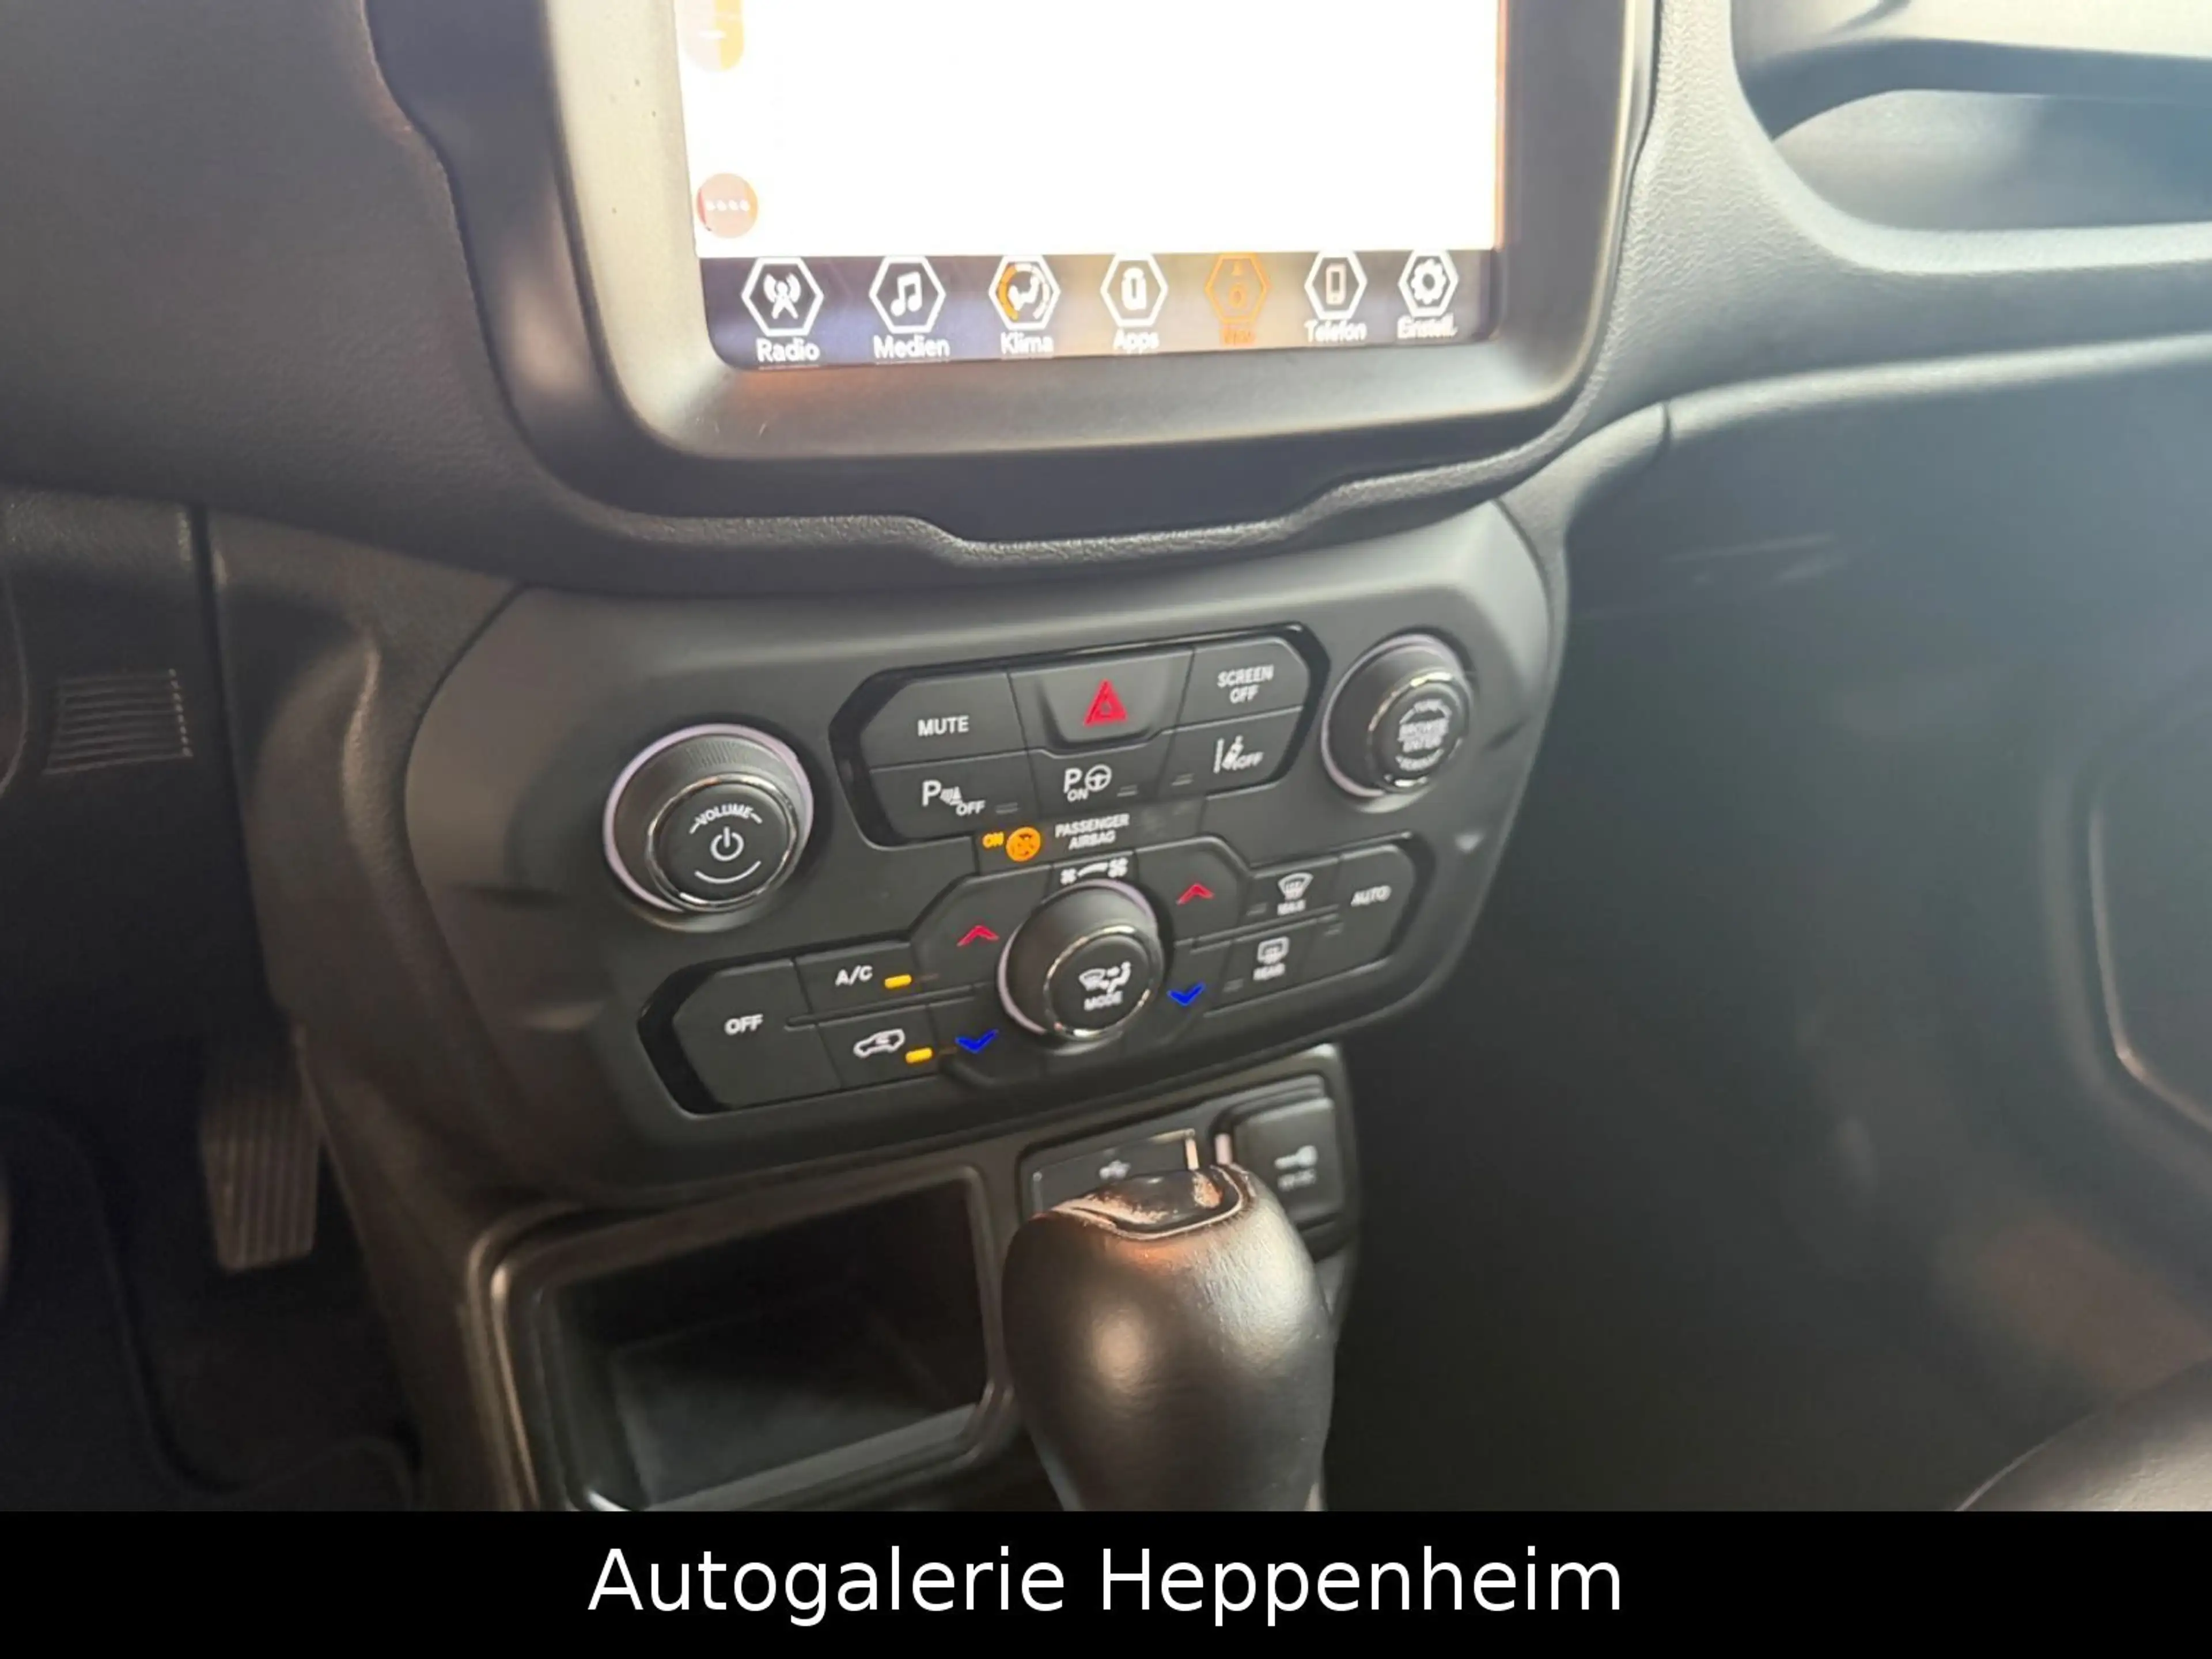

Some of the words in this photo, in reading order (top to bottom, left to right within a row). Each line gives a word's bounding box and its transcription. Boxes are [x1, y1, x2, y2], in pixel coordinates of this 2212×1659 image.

[1113, 328, 1160, 354] Apps
[1304, 320, 1367, 342] Telefon
[756, 335, 821, 362] Radio
[873, 336, 950, 358] Medien
[1001, 333, 1054, 353] Klima
[1217, 664, 1274, 688] SCREEN
[1229, 685, 1260, 704] OFF
[918, 715, 969, 737] MUTE
[1063, 767, 1082, 794] P
[922, 779, 942, 806] P
[1067, 788, 1089, 802] ON
[696, 804, 752, 825] VOLUME
[956, 800, 986, 816] OFF
[1055, 813, 1130, 838] PASSENGER
[982, 832, 1004, 849] ON
[1068, 830, 1116, 850] AIRBAG
[1350, 885, 1392, 907] AUTO
[835, 965, 873, 986] A/C
[1084, 991, 1123, 1011] MODE
[724, 1013, 764, 1036] OFF
